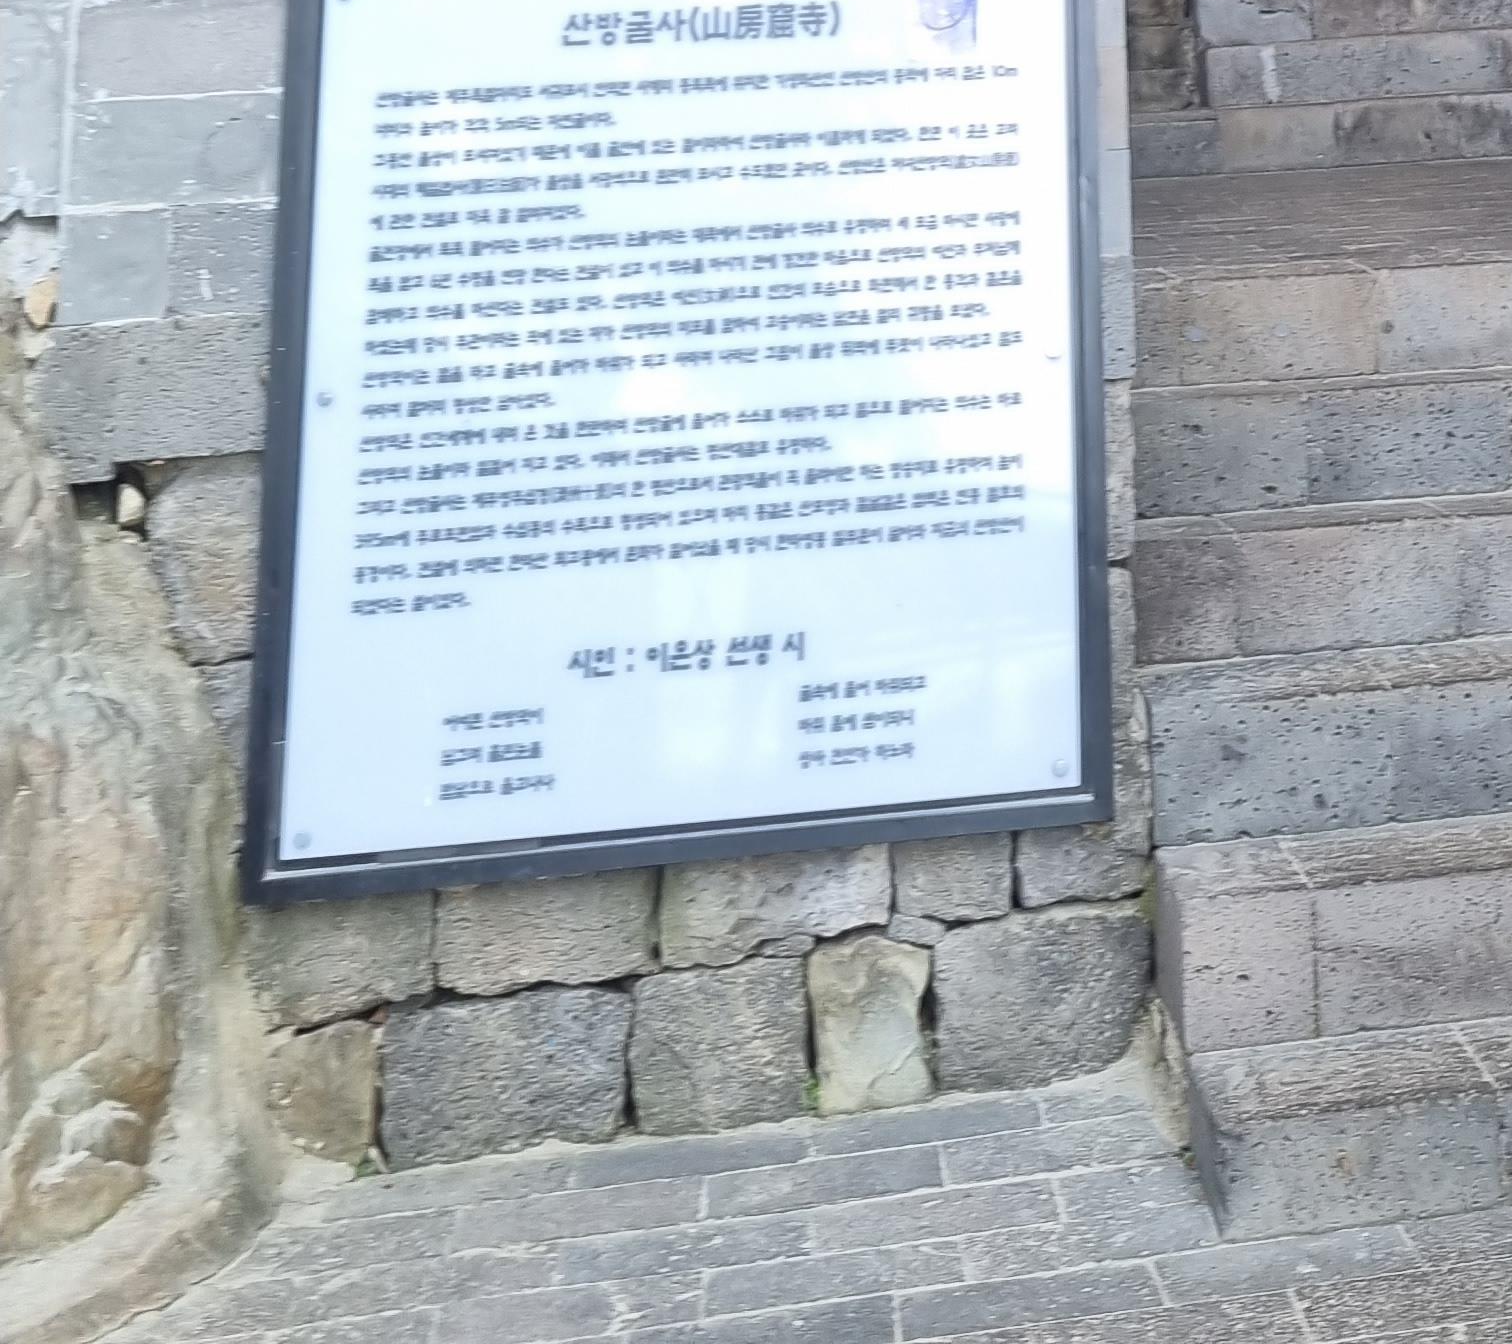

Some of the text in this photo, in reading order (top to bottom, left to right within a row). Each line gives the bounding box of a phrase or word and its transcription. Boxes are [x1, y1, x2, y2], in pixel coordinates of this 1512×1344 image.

[561, 3, 841, 46] 산방굴사(山房窟寺)
[568, 646, 615, 678] 시인
[646, 638, 714, 672] 이은상
[725, 634, 773, 665] 선생
[782, 631, 805, 661] 시
